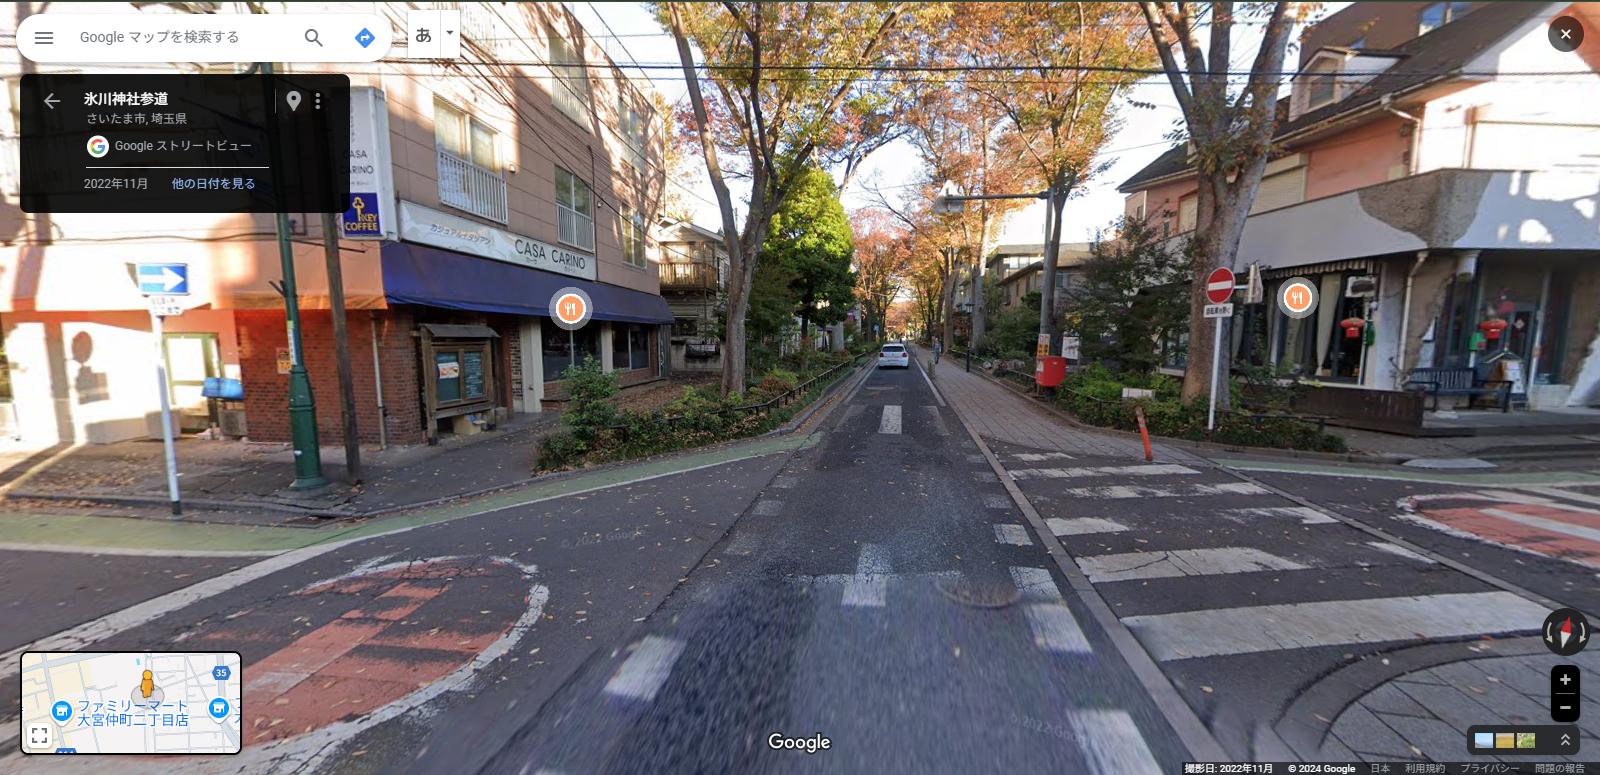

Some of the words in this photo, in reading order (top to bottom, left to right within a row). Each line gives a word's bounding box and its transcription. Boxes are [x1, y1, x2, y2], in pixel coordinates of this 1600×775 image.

[343, 150, 367, 159] ASA
[340, 165, 374, 175] ARINO
[361, 213, 378, 222] KEY
[345, 222, 378, 231] COFFEE
[514, 239, 546, 260] CASA
[551, 249, 586, 270] CARINO
